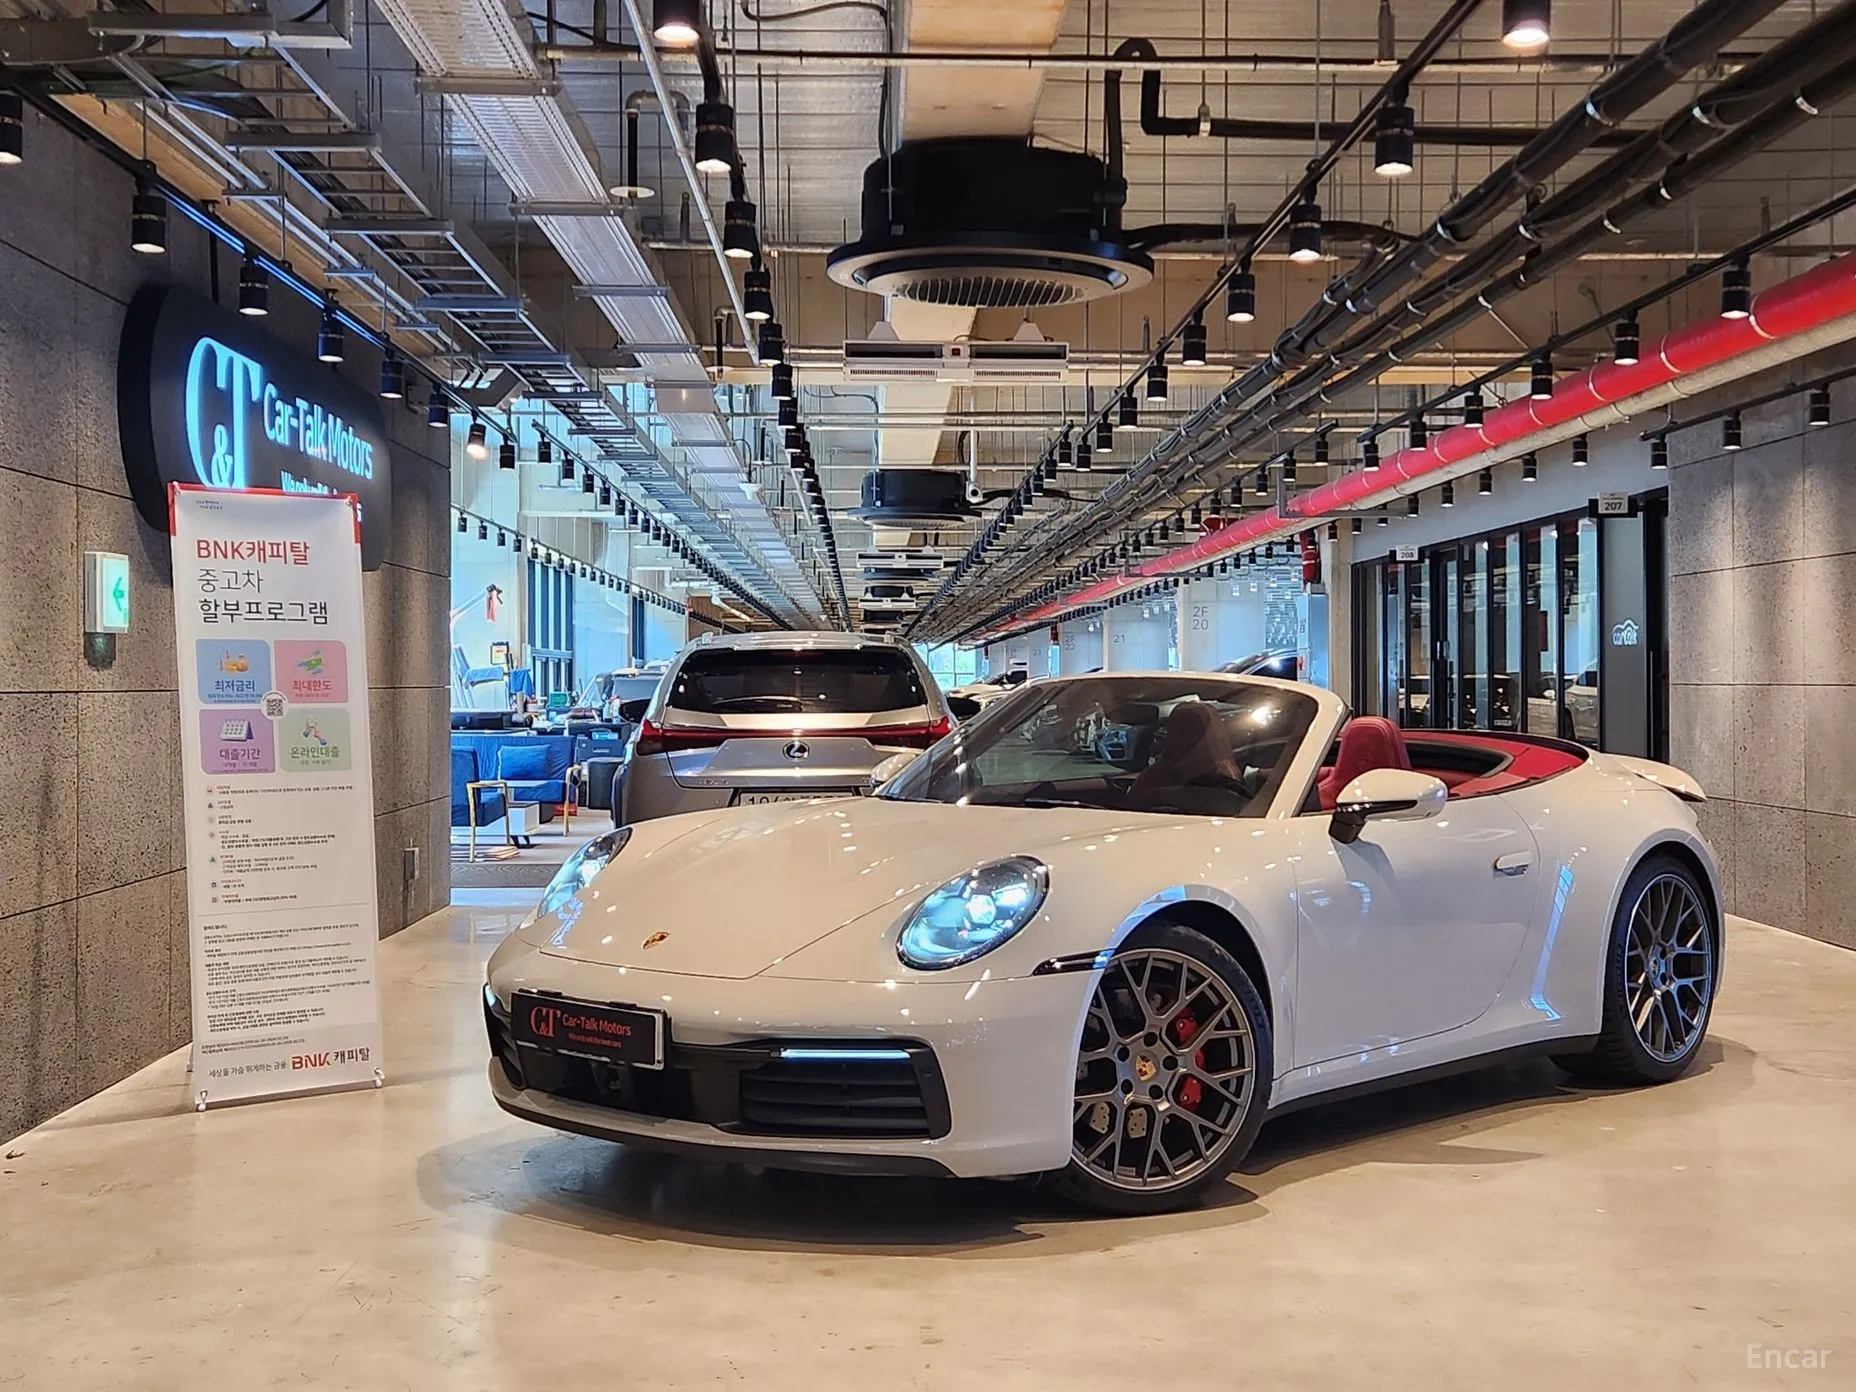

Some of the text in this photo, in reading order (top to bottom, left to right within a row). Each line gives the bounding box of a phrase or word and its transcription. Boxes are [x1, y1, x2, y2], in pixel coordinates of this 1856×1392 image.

[263, 382, 373, 480] Car-Talk Motors
[1603, 501, 1623, 511] 207
[196, 539, 310, 566] BNK캐피탈
[197, 568, 264, 594] 중고차
[198, 597, 328, 625] 할부프로그램
[1192, 606, 1209, 618] 2F
[1192, 619, 1209, 630] 20
[1113, 634, 1126, 643] 21
[1065, 643, 1076, 651] 22
[214, 680, 256, 692] 최저금리
[292, 680, 332, 692] 최대한도
[219, 748, 261, 760] 대출기간
[290, 746, 340, 759] 온라인대출
[562, 1014, 632, 1036] Car-Talk Motors
[291, 1046, 370, 1070] BNK 캐피탈
[209, 1067, 229, 1078] 세상을
[231, 1066, 244, 1075] 가슴
[274, 1061, 287, 1071] 금융
